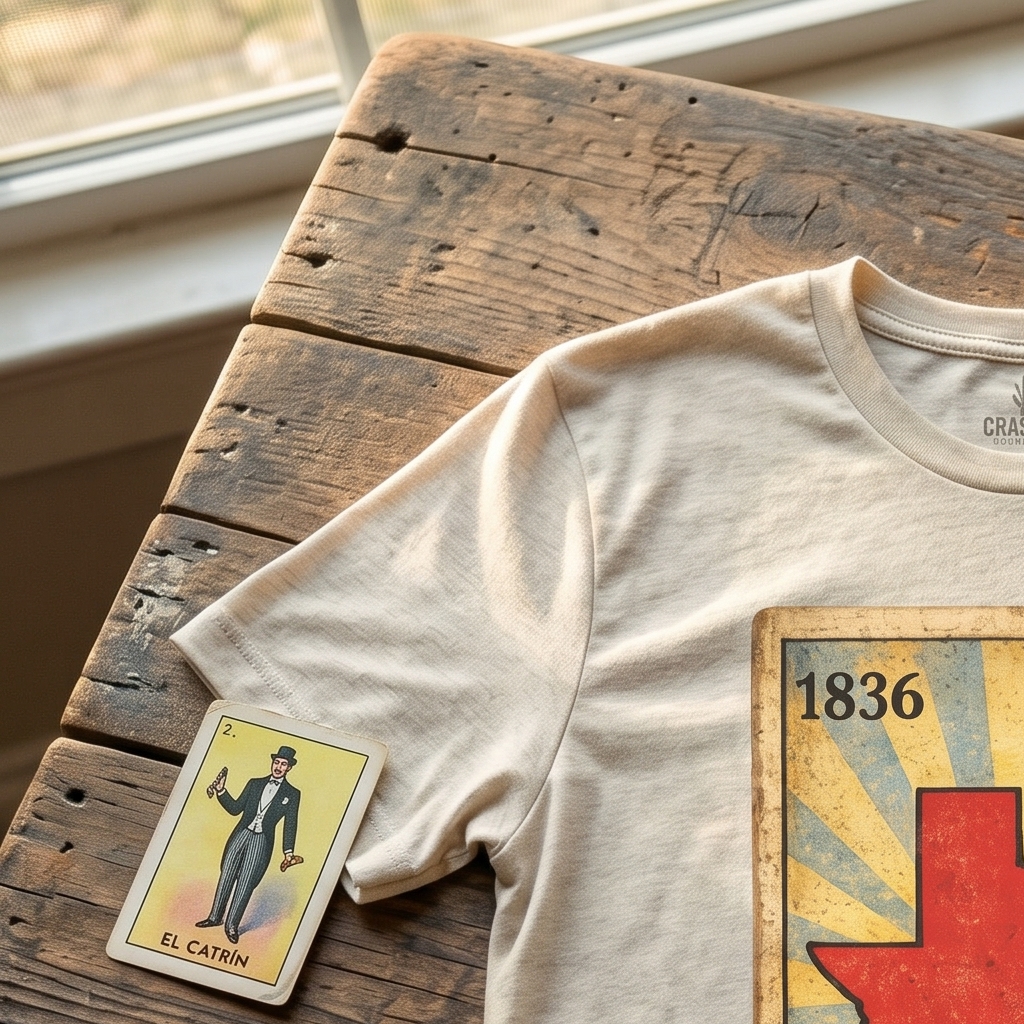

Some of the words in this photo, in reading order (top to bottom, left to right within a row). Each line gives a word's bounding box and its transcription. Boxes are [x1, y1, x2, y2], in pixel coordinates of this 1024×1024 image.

[795, 671, 924, 720] 1836
[160, 931, 180, 950] EL
[186, 939, 250, 969] CATRÍN
